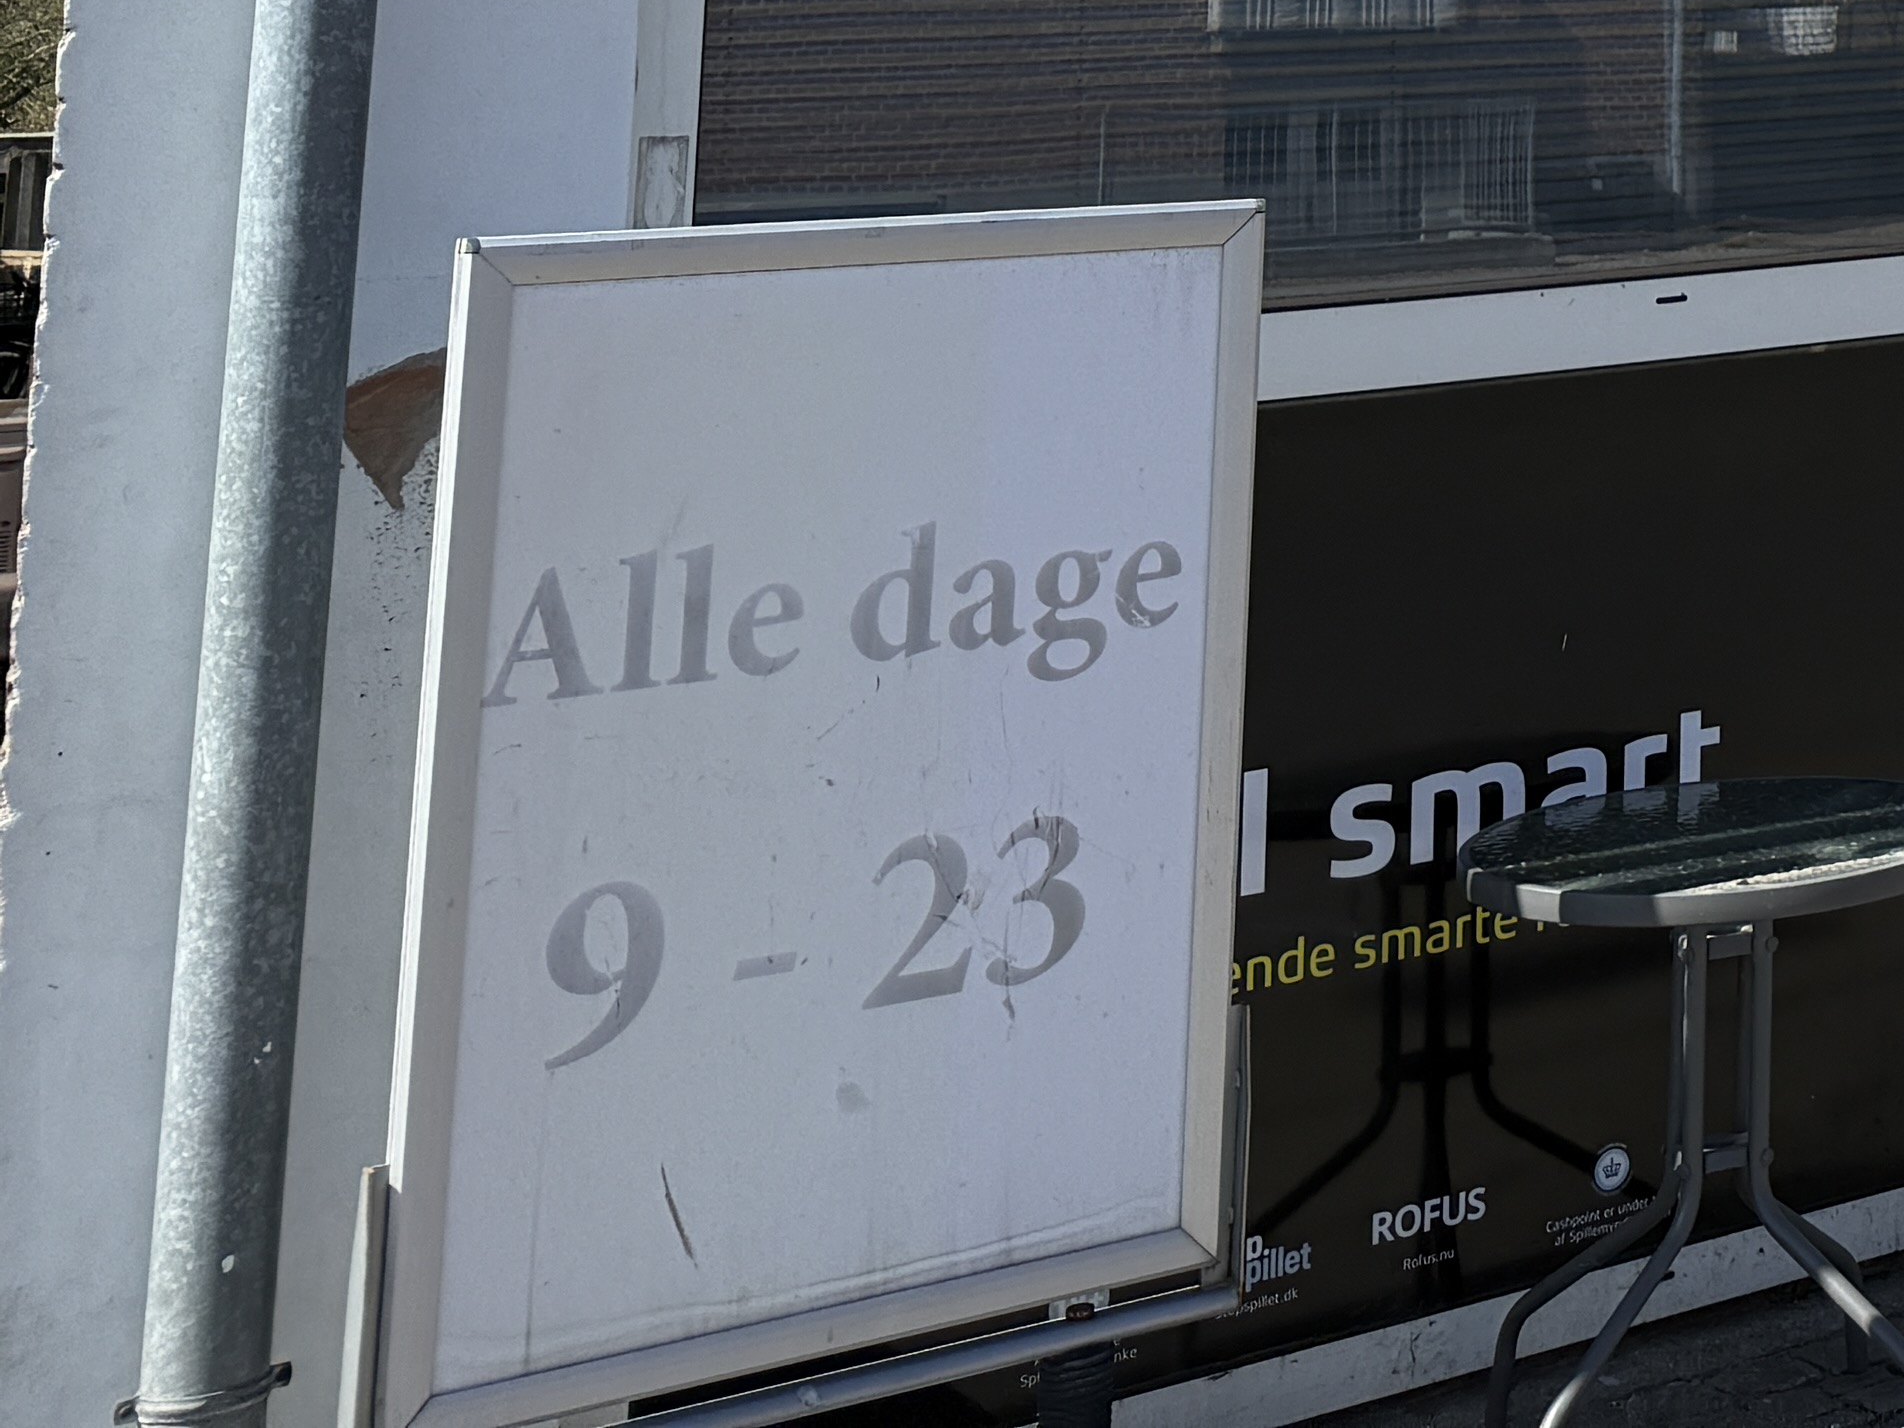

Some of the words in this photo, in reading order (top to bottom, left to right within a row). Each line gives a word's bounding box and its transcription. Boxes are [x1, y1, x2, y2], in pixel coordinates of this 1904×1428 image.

[479, 544, 804, 708] Alle
[850, 519, 1182, 683] dage
[545, 879, 665, 1072] 9
[861, 814, 1087, 1011] 23
[1371, 1186, 1488, 1246] ROFUS
[1545, 1209, 1601, 1234] Cashpoint
[1402, 1248, 1456, 1273] Rofus.nu
